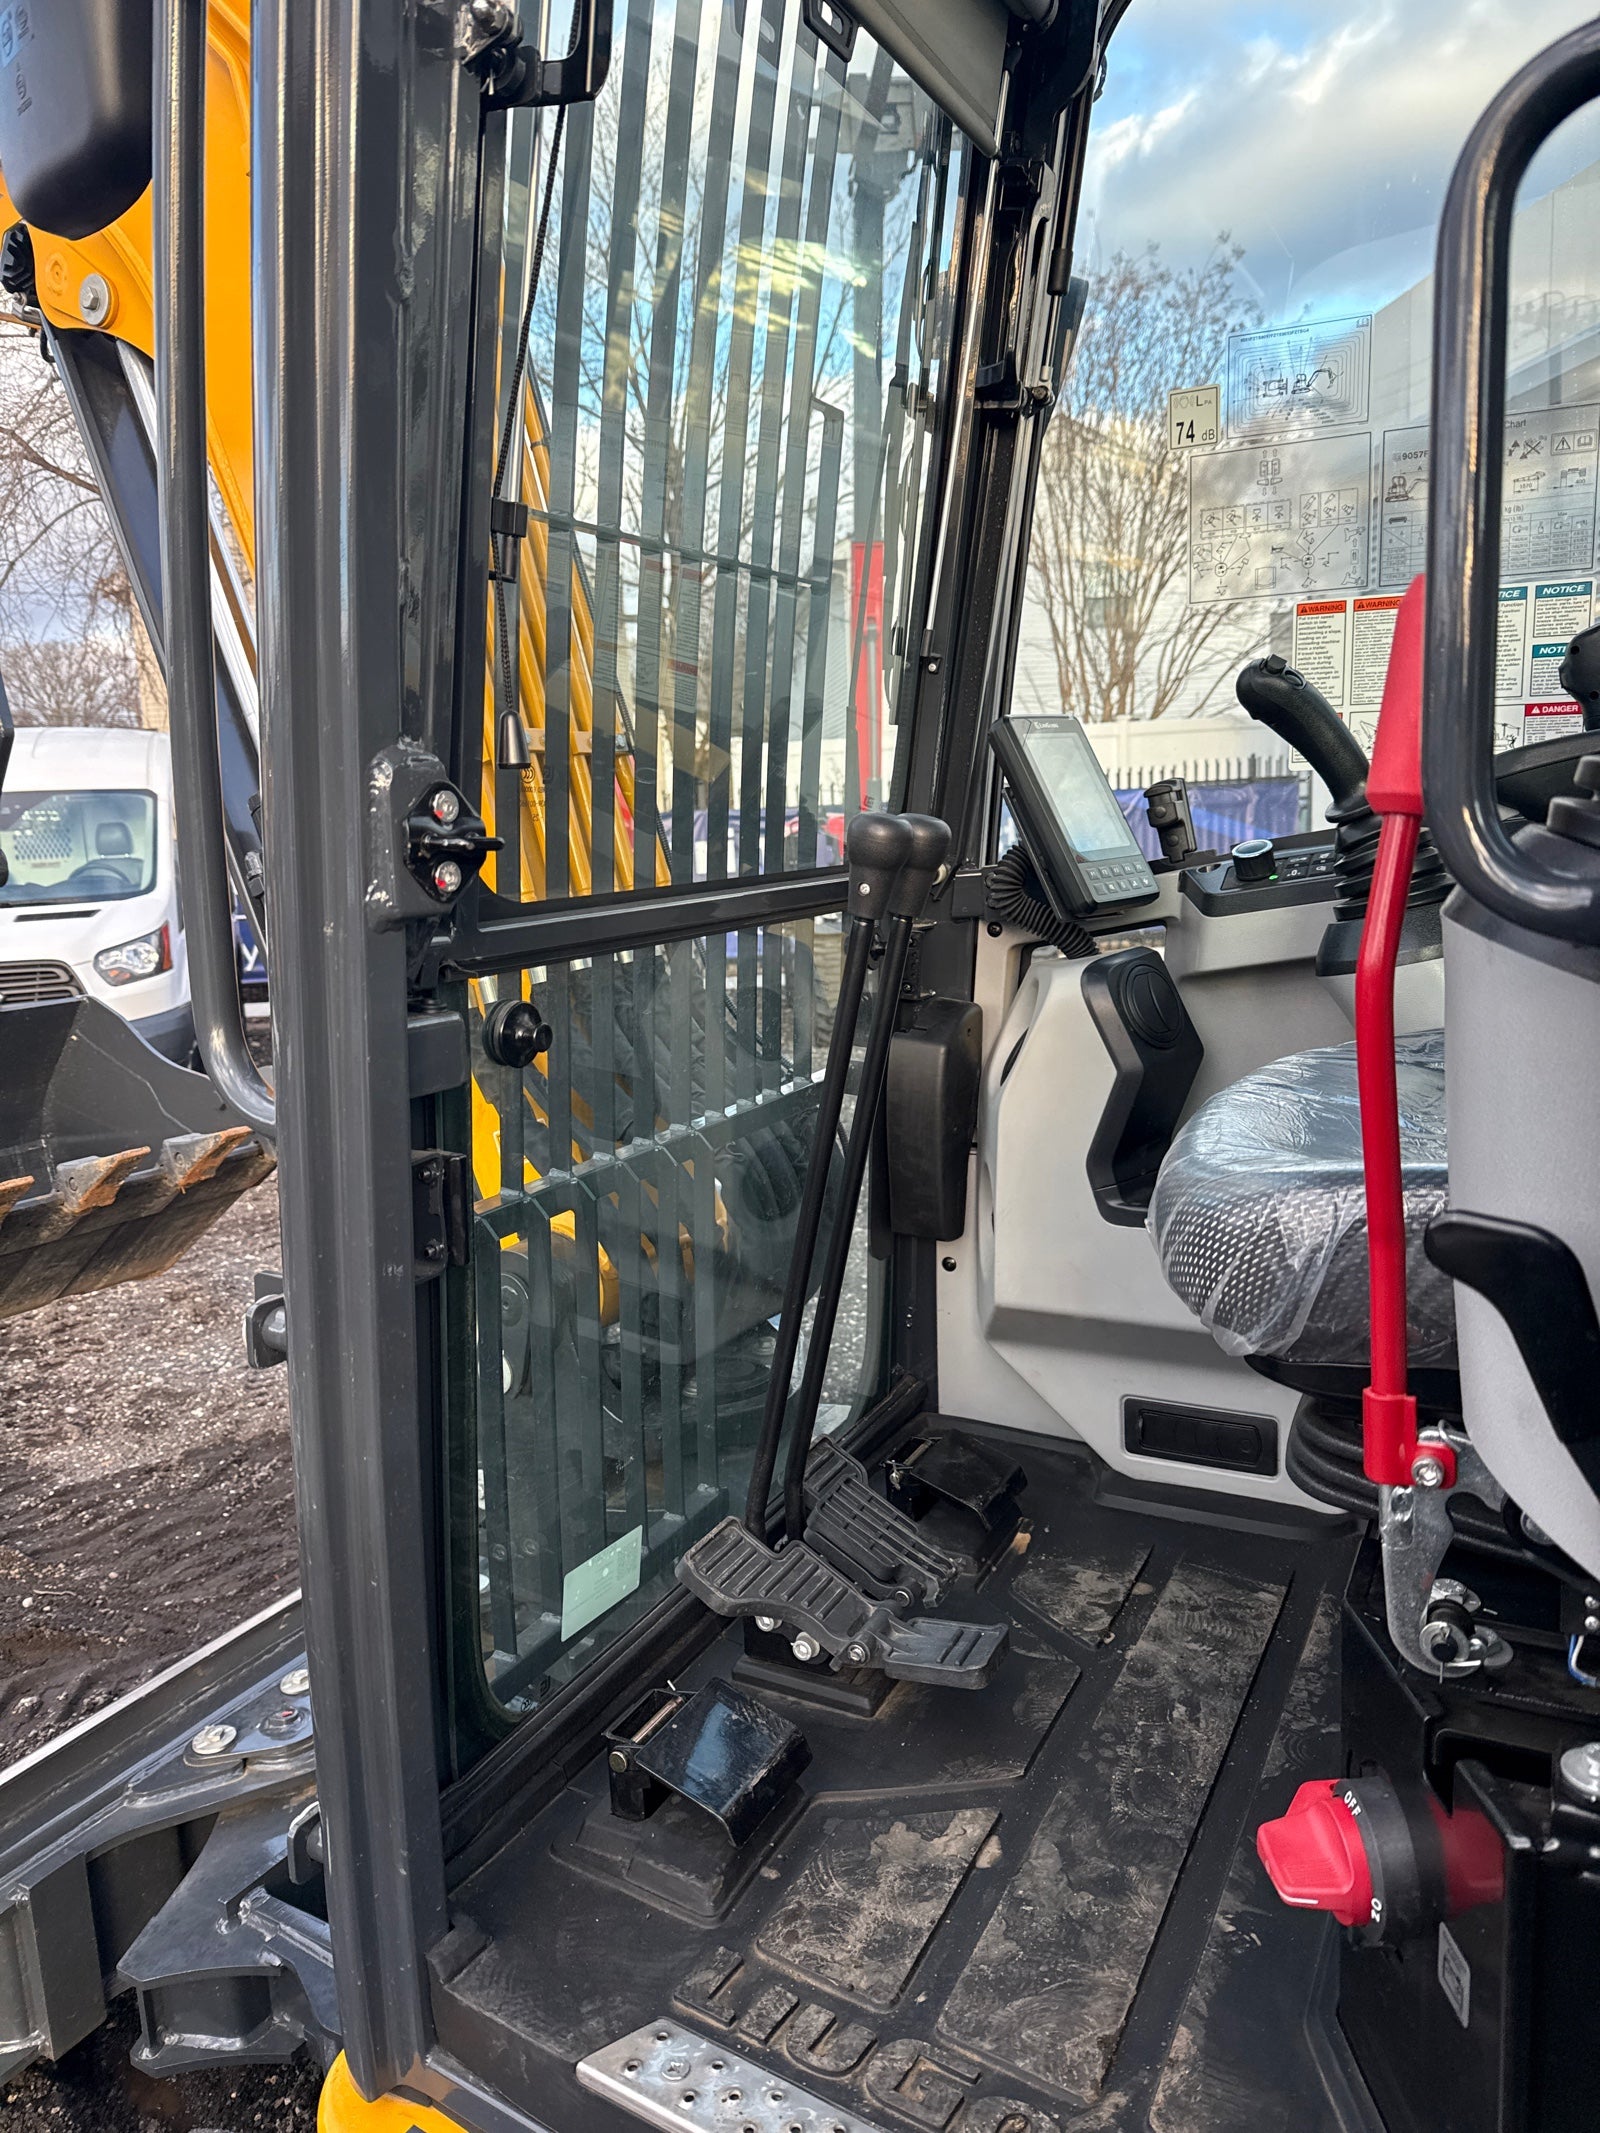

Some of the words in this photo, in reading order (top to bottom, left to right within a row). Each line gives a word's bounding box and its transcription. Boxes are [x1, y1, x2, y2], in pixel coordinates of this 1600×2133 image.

[1176, 419, 1195, 445] 74
[1202, 428, 1215, 441] dB
[1498, 590, 1521, 598] TICE
[1542, 584, 1585, 594] NOTICE
[1308, 604, 1343, 612] WARNING
[1539, 646, 1566, 654] NOTI
[1542, 705, 1579, 713] DANGER
[1344, 1791, 1361, 1816] OFF
[1371, 1898, 1382, 1922] ON
[673, 1945, 1128, 2133] LIUG
